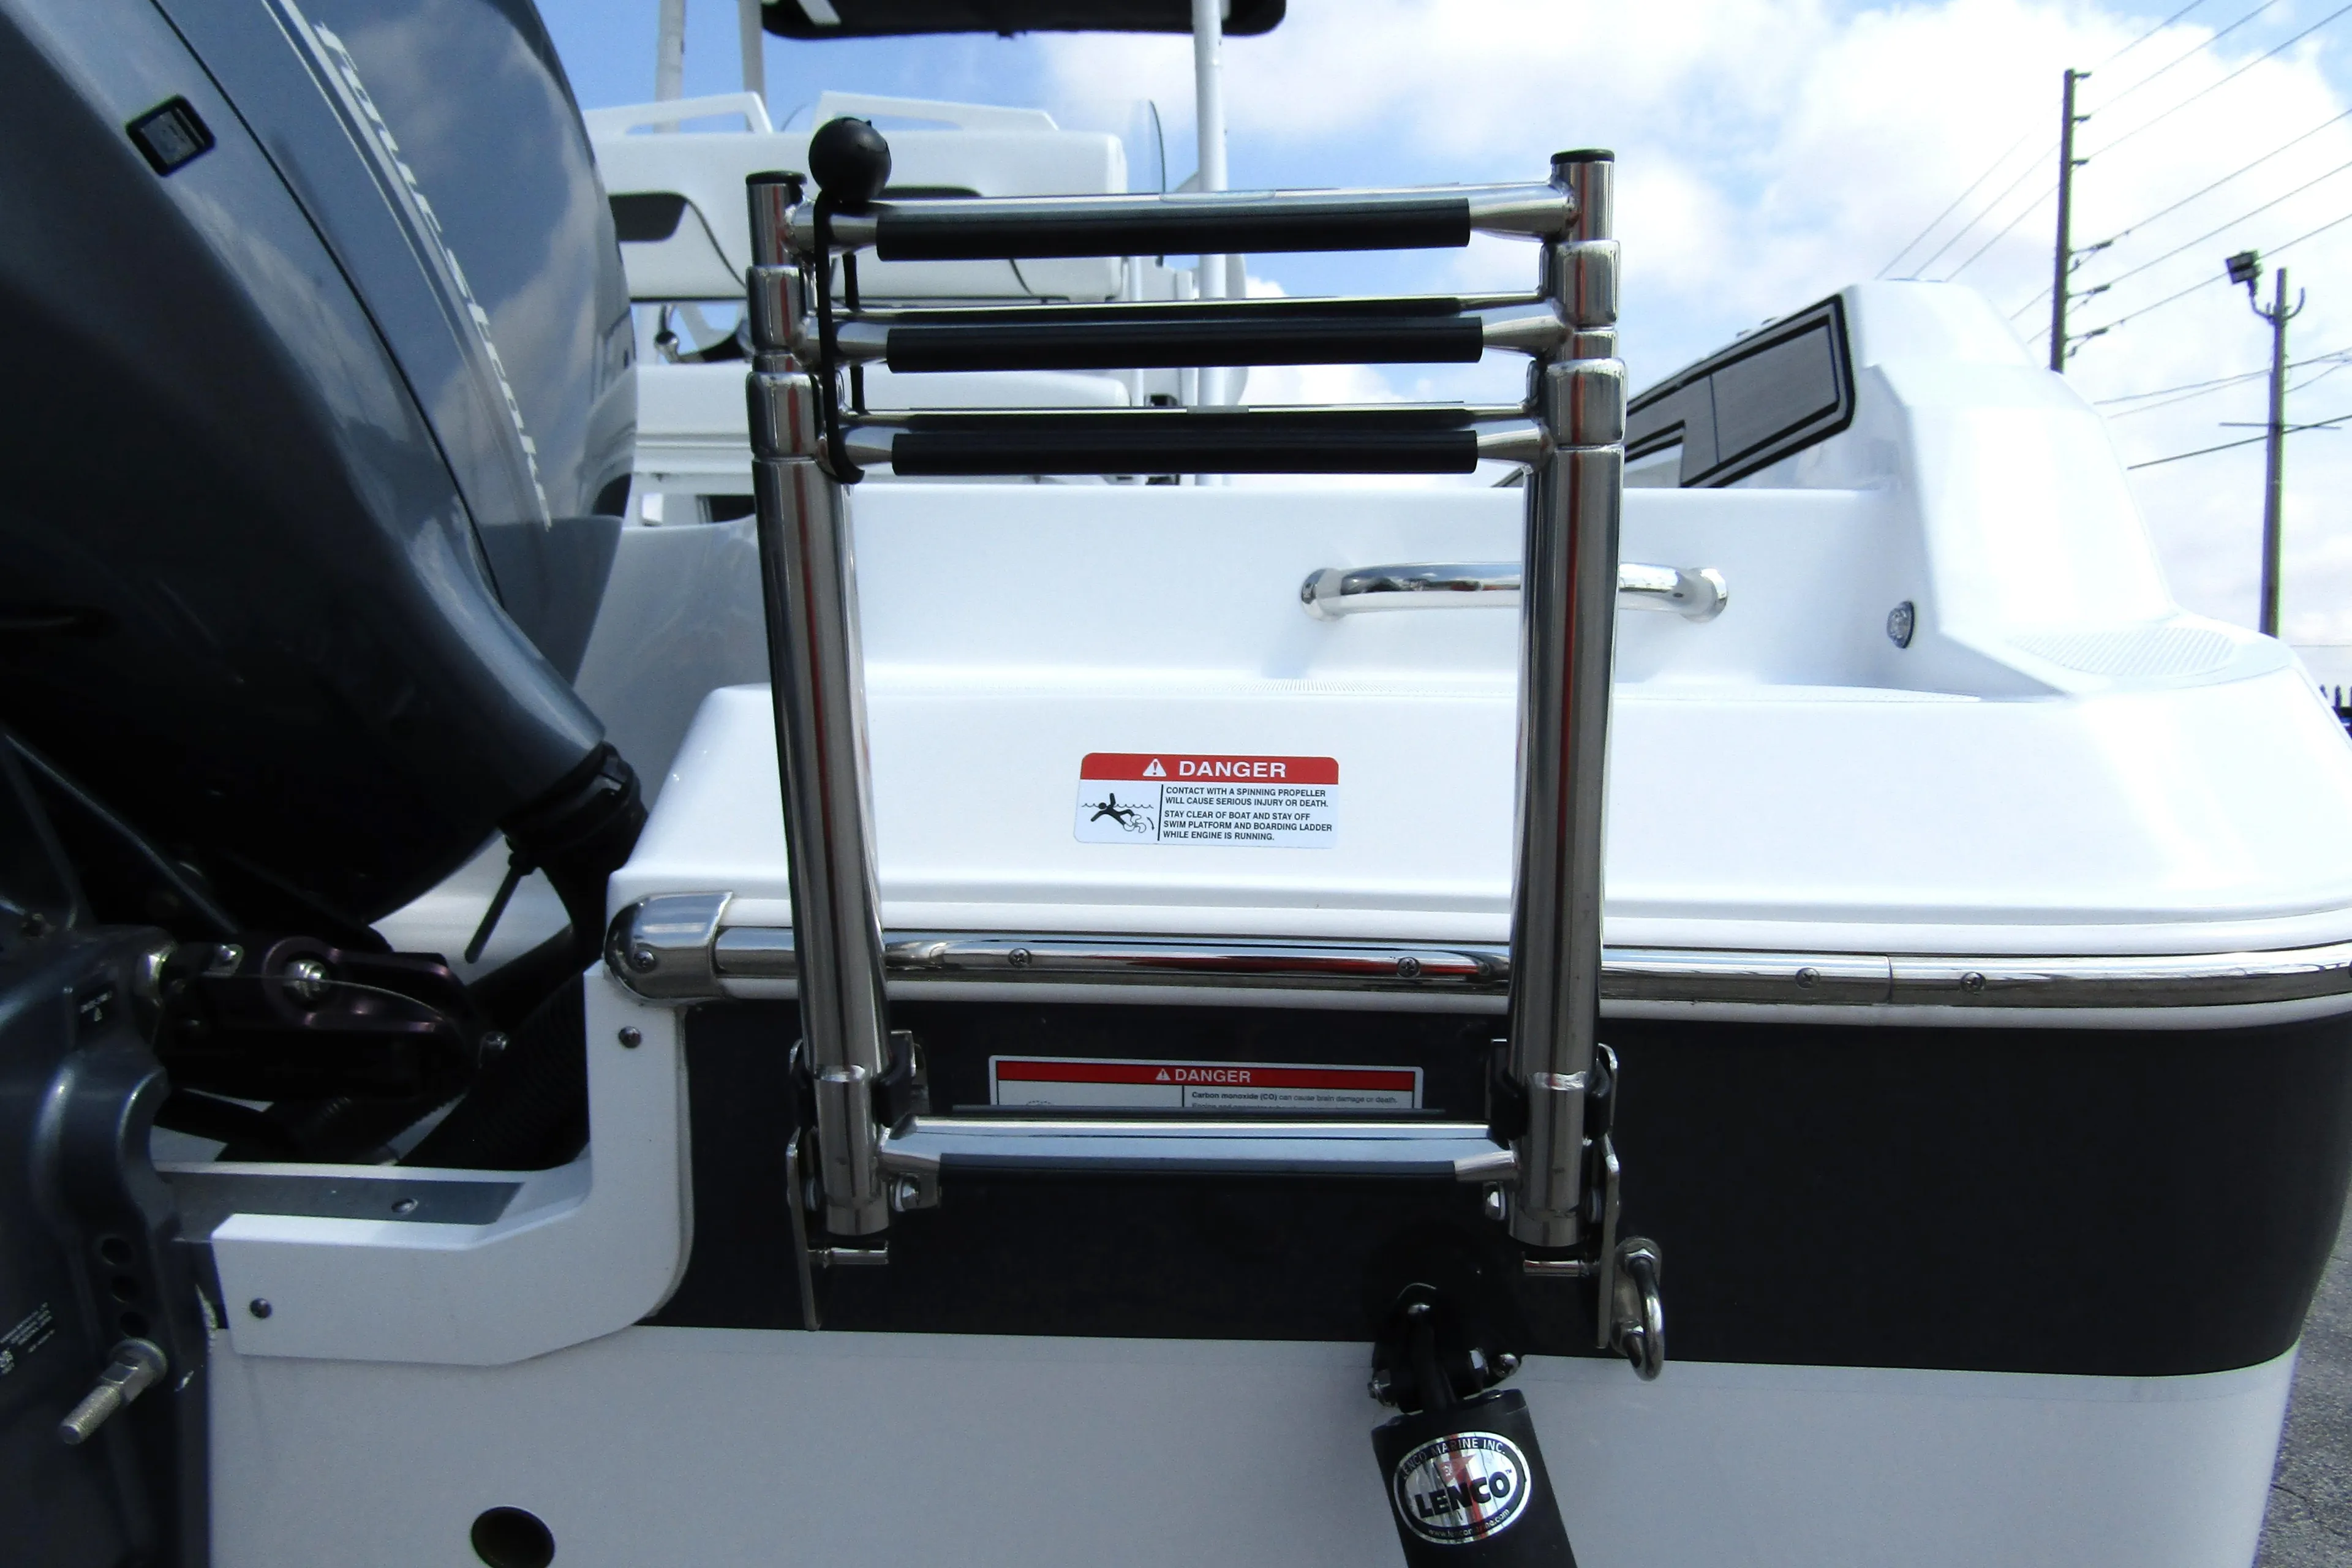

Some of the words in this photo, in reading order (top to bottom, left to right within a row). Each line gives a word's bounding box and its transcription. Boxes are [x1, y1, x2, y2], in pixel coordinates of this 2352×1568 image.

[1179, 761, 1286, 778] DANGER
[1175, 1068, 1251, 1083] DANGER
[1431, 1438, 1478, 1455] MARINE
[1483, 1439, 1506, 1454] INC.
[1415, 1472, 1510, 1518] LENCO
